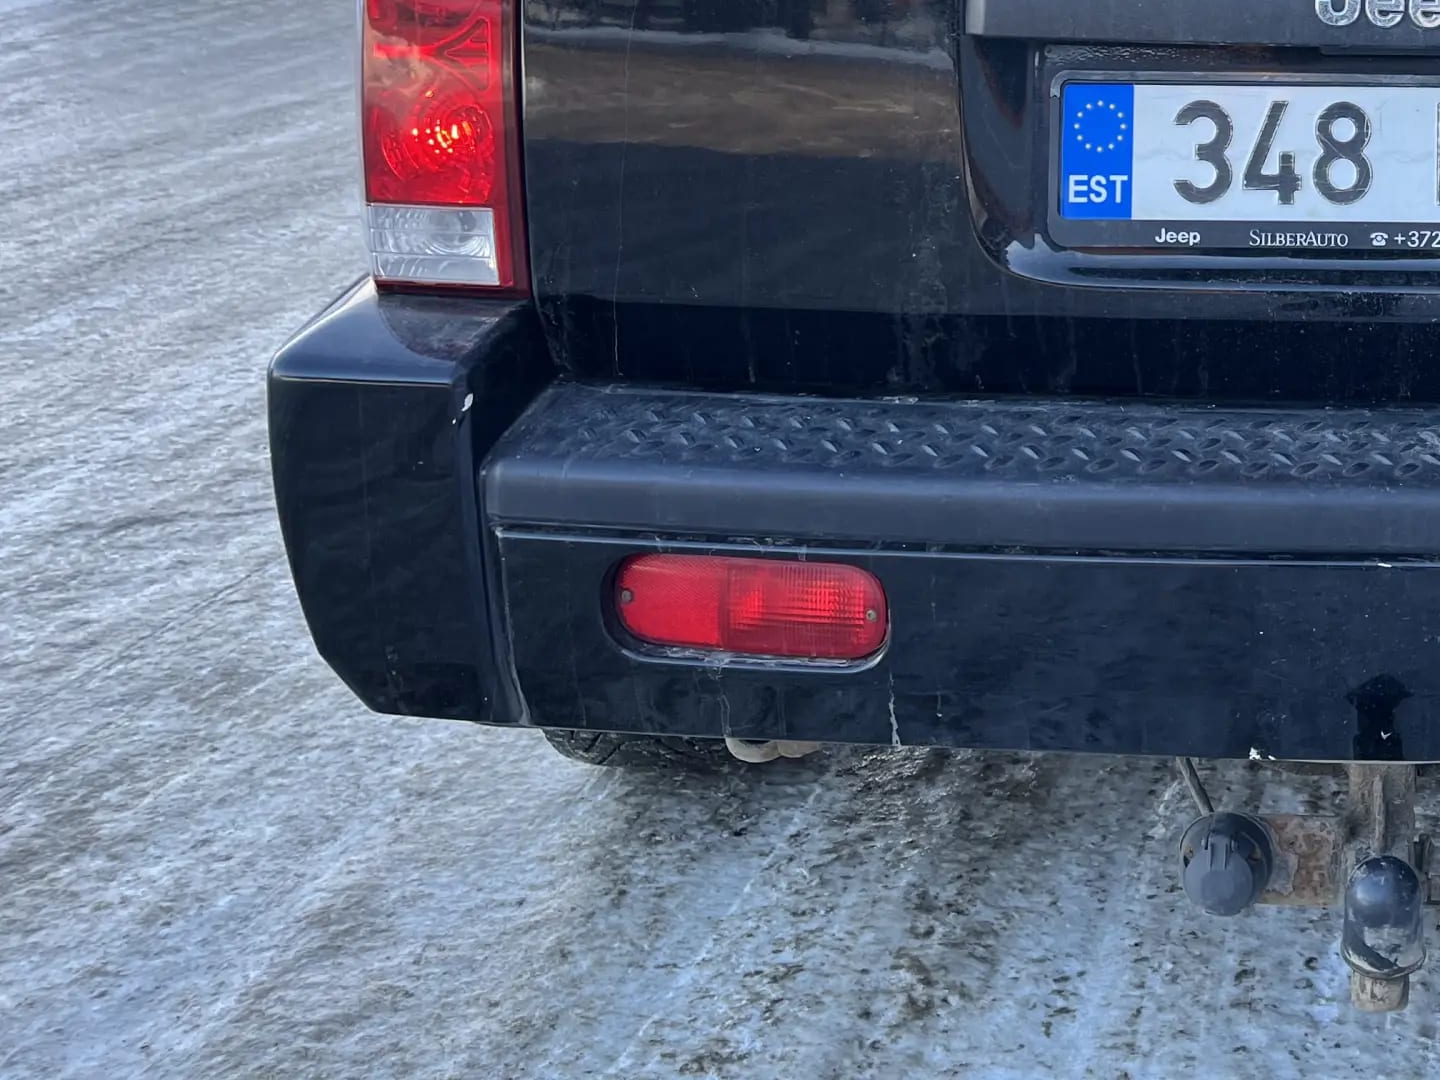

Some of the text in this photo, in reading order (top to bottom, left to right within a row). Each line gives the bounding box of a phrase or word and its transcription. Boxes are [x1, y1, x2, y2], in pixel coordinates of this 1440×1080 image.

[1173, 99, 1374, 206] 348
[1068, 174, 1129, 204] EST
[1155, 228, 1200, 246] Jeep
